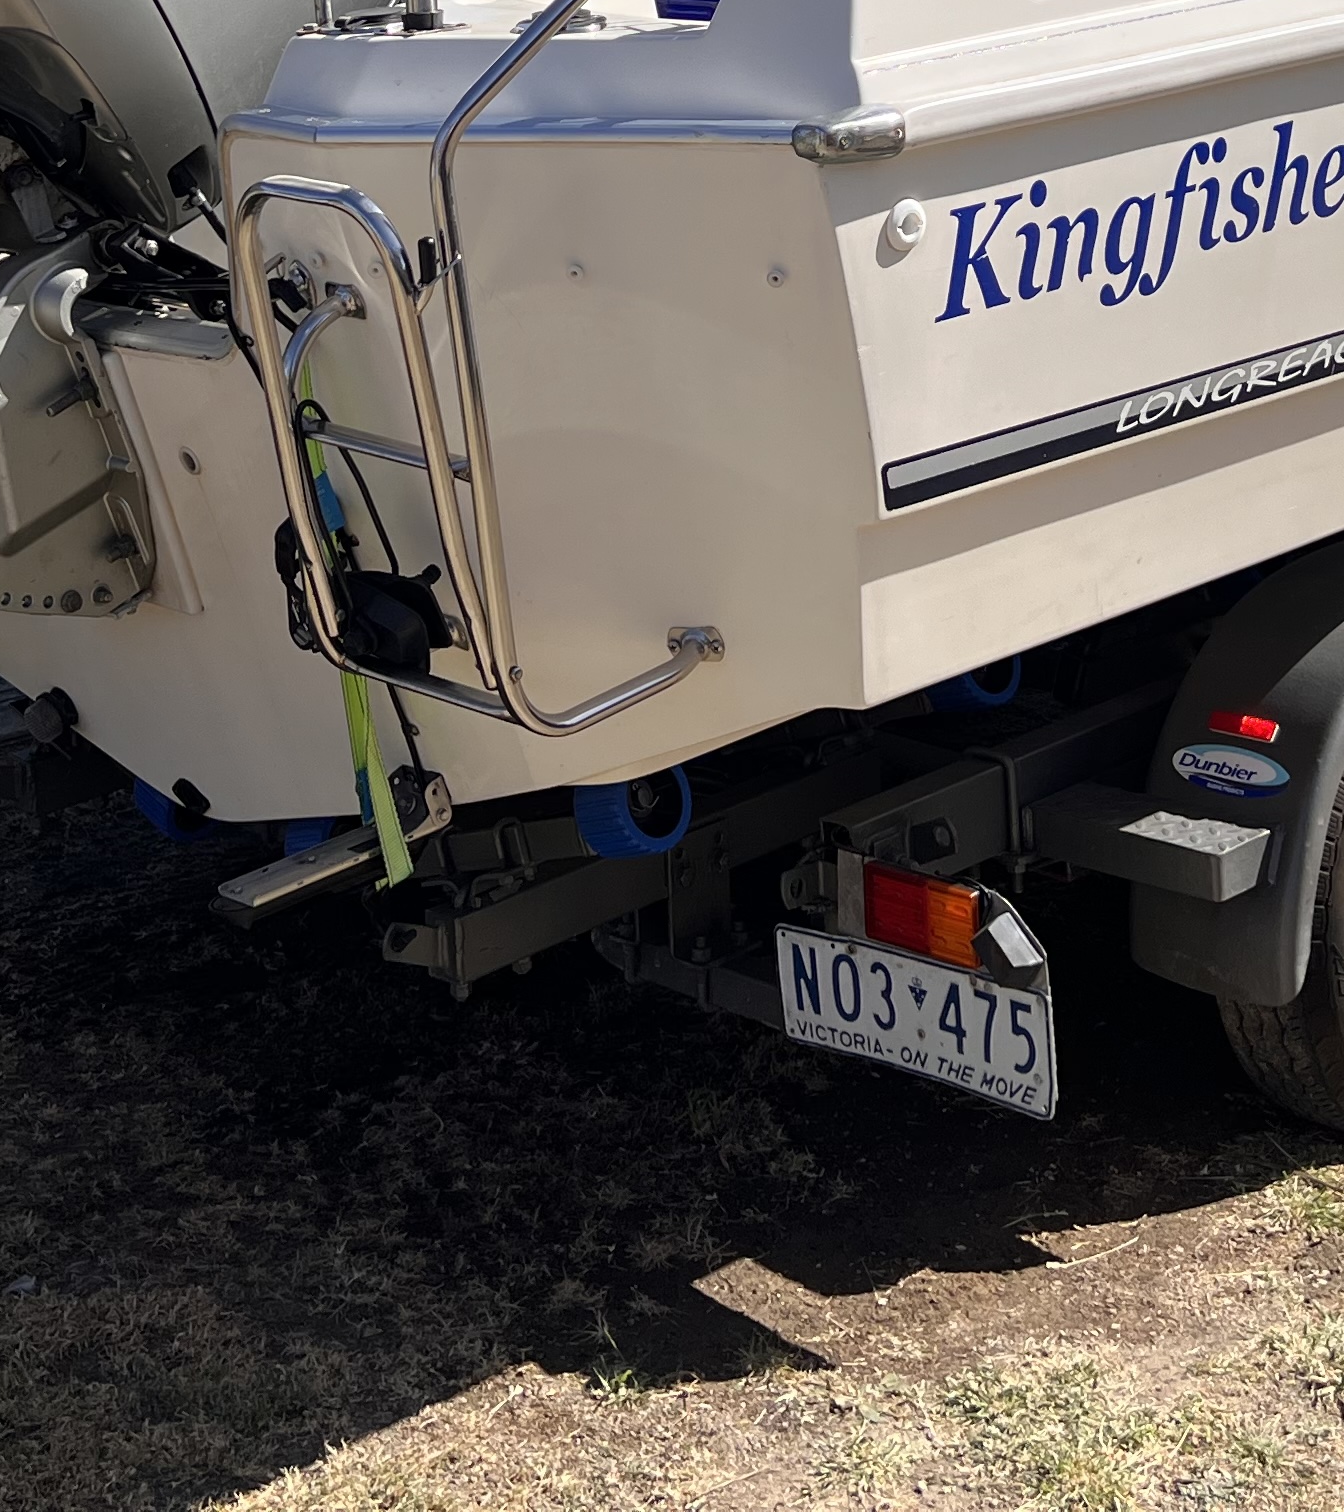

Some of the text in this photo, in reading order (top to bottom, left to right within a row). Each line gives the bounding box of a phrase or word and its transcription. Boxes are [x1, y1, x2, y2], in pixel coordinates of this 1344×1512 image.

[1178, 752, 1258, 781] Dunbier
[938, 982, 1037, 1075] 475
[901, 1047, 929, 1070] ON
[937, 1055, 976, 1086] THE
[979, 1072, 1038, 1106] MOVE
